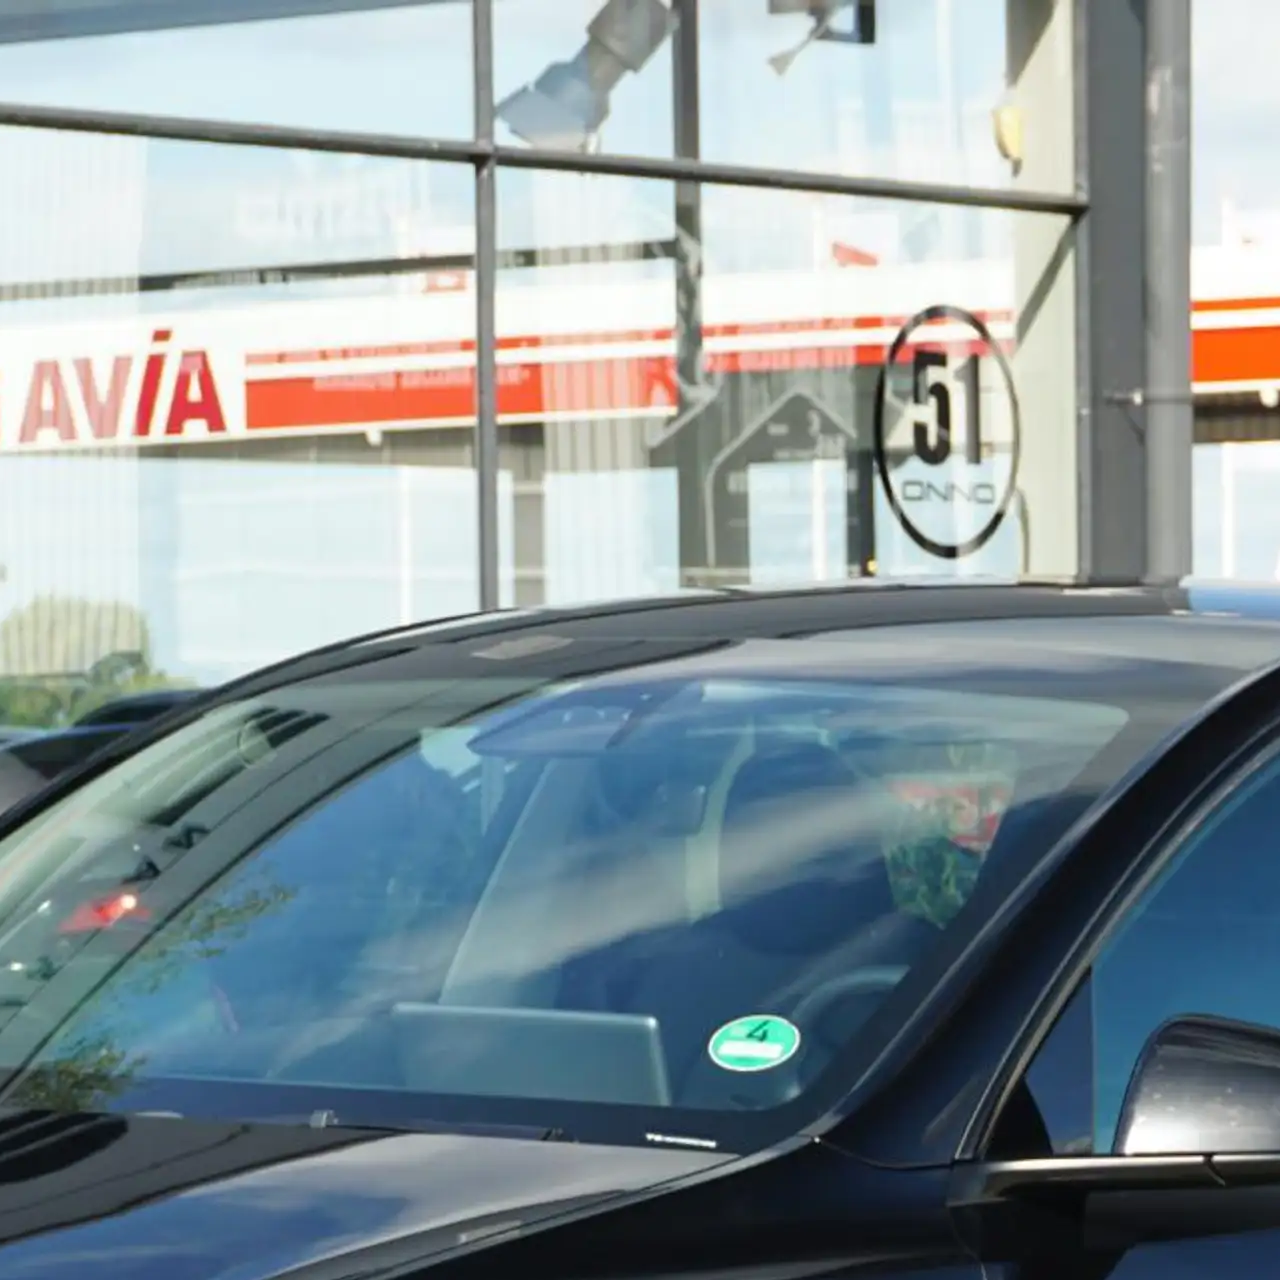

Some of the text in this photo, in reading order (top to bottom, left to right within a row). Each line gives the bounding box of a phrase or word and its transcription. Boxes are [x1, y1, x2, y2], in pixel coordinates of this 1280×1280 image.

[19, 328, 226, 442] AVIA
[913, 350, 981, 466] 51
[746, 1019, 771, 1042] 4
